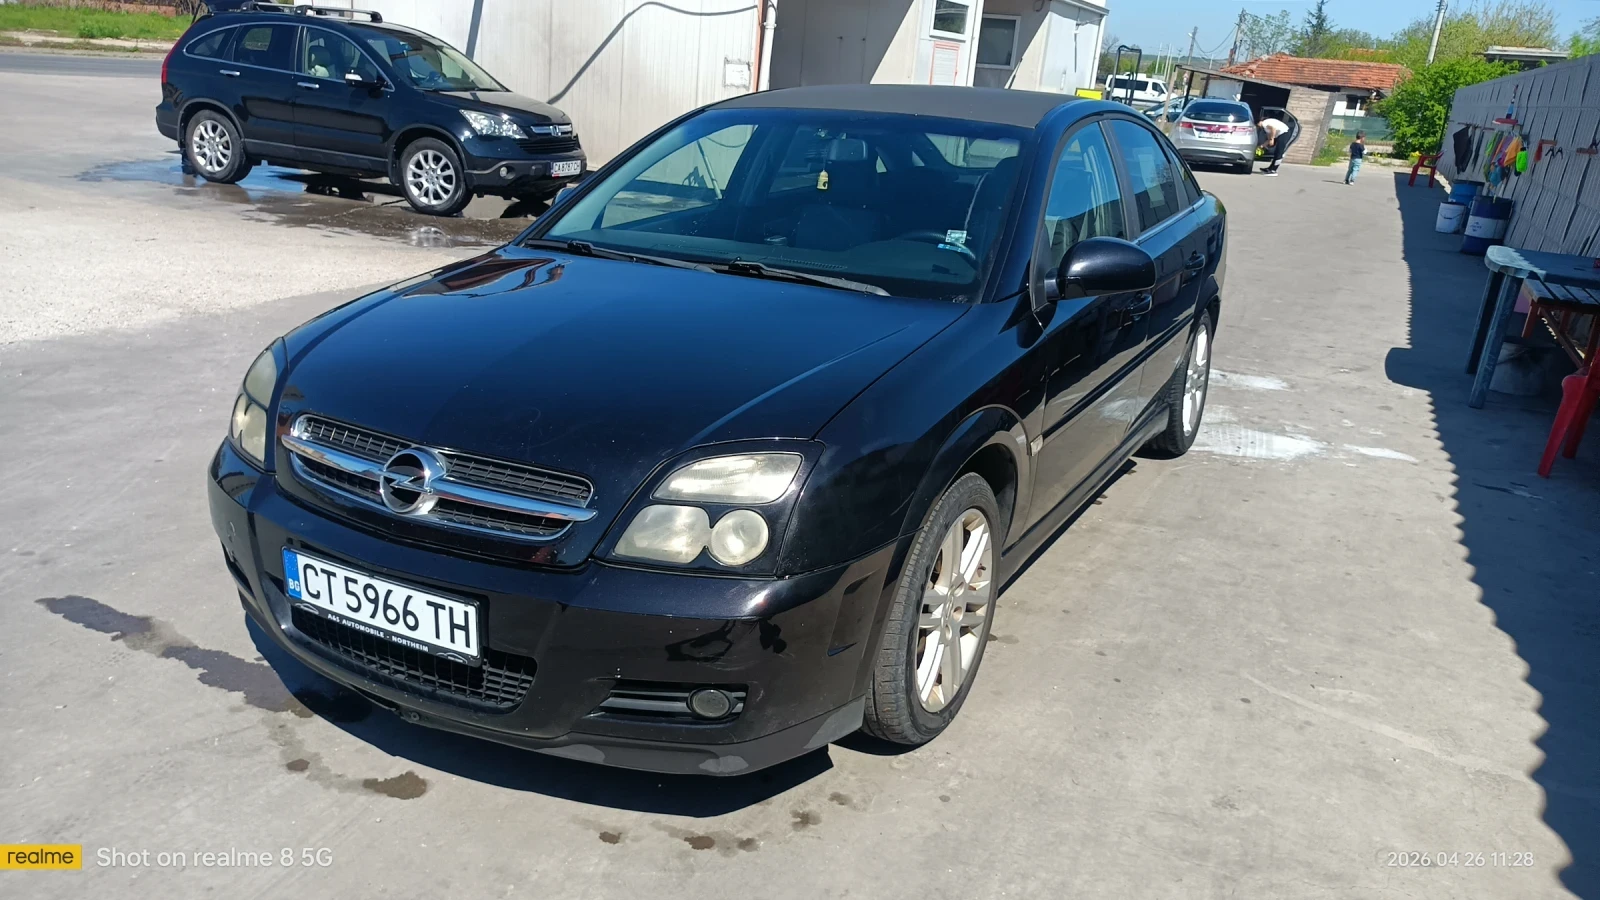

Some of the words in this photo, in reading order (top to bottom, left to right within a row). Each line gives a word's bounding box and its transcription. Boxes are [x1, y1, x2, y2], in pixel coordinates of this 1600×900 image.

[288, 578, 300, 592] BG
[303, 563, 337, 605] CT
[344, 575, 419, 631] 5966
[426, 600, 471, 649] TH
[327, 613, 340, 623] A&S
[342, 618, 384, 639] AUTOMOBILE
[392, 635, 429, 652] NORTHEIM
